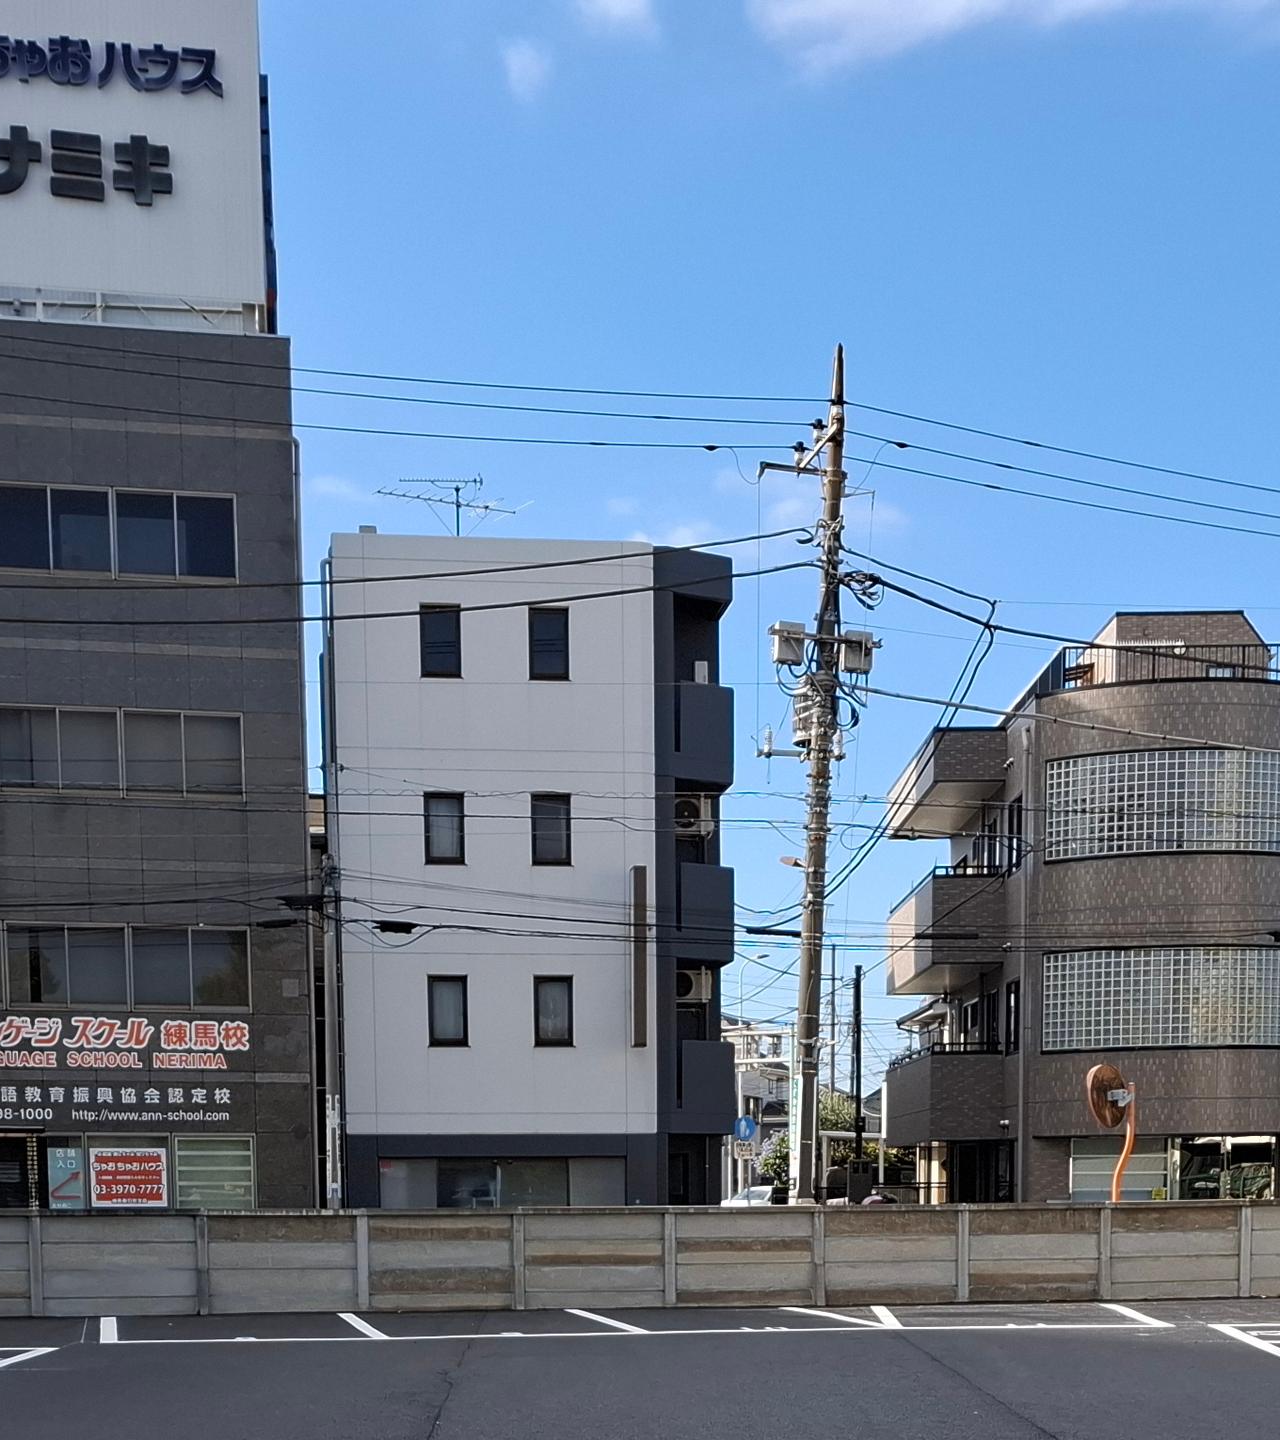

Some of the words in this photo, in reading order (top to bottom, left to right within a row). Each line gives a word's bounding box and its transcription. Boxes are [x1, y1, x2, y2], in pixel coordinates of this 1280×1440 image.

[67, 1051, 143, 1068] SCHOOL
[153, 1053, 227, 1069] NERIMA
[71, 1109, 230, 1122] http://www.ann-school.com
[94, 1184, 164, 1194] 03-3970-7777
